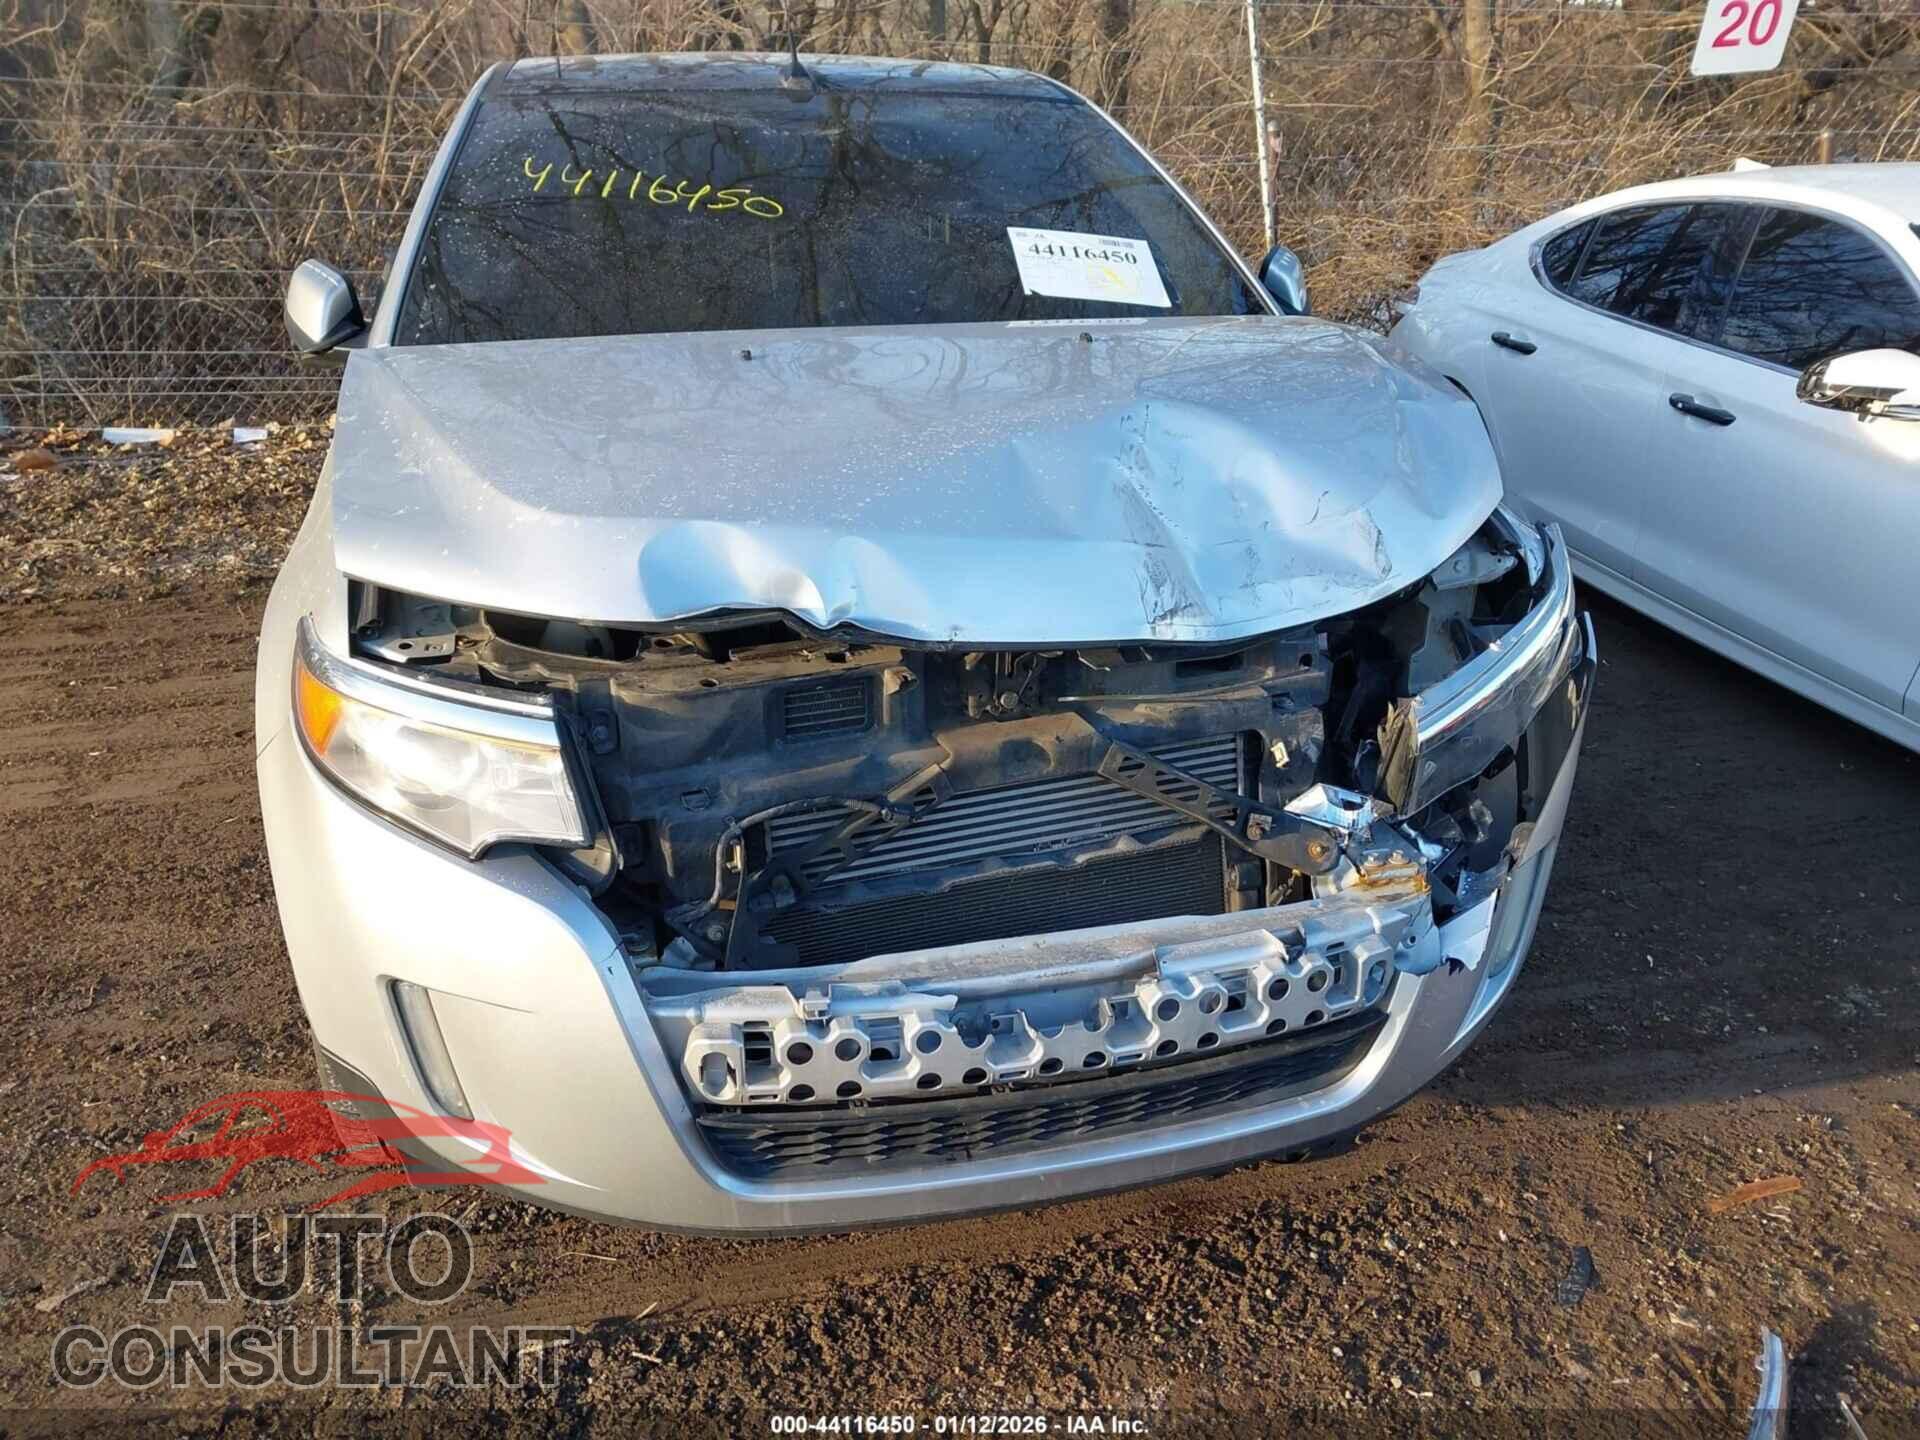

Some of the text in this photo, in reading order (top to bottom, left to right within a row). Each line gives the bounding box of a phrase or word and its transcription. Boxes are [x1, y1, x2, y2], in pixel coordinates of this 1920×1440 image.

[1712, 0, 1783, 48] 20
[524, 156, 783, 218] 44116450
[1028, 243, 1138, 265] 44116450
